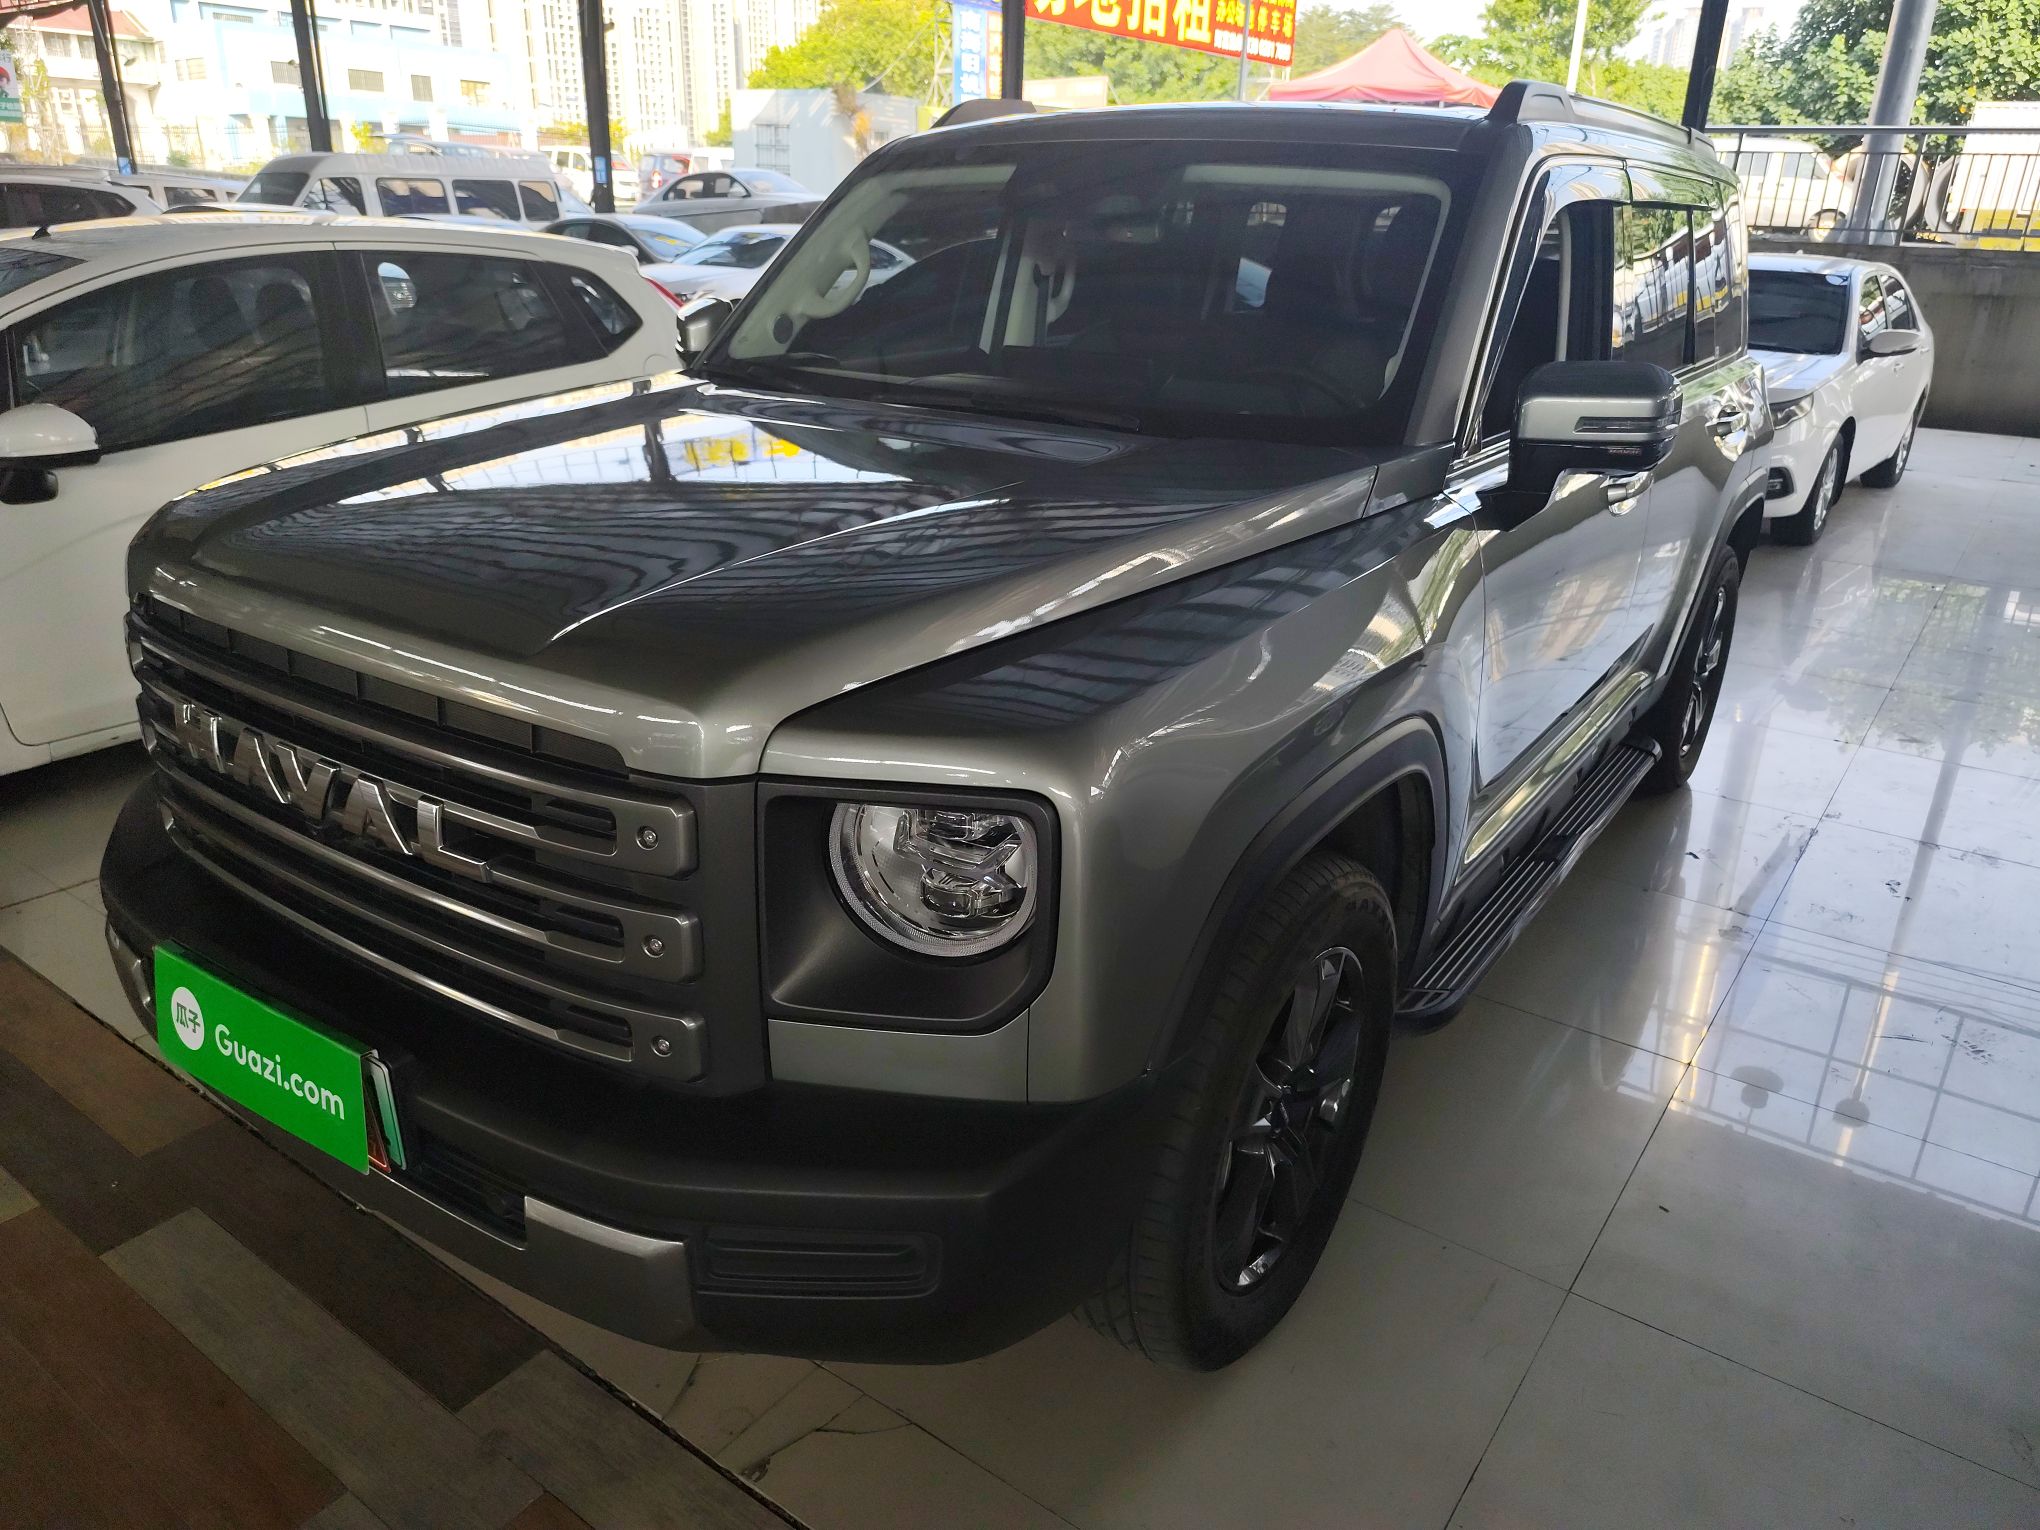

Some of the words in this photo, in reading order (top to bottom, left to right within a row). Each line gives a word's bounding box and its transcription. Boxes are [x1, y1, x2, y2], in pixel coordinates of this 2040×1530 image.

[176, 703, 492, 884] HAVAL
[176, 1002, 201, 1034] 瓜子
[215, 1024, 345, 1120] Guazi.com
